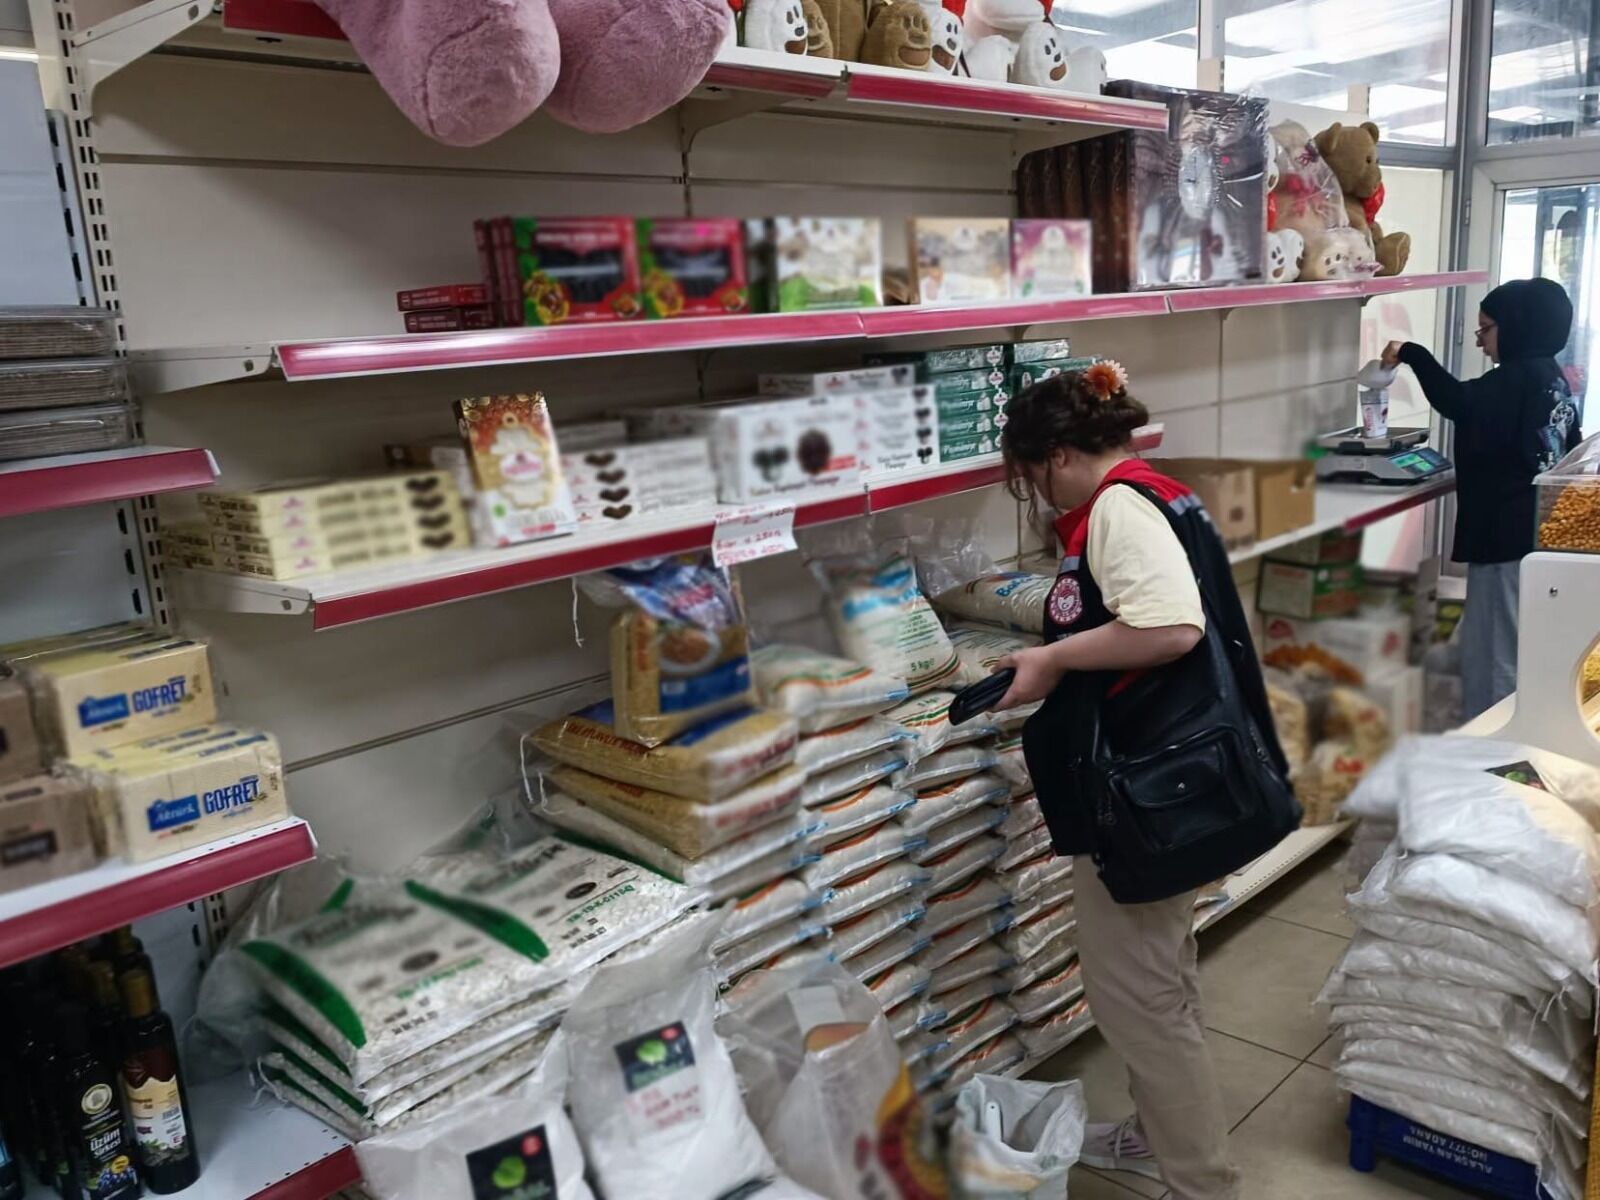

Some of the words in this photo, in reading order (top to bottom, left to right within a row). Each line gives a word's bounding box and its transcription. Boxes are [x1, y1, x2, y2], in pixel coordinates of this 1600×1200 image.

[132, 679, 186, 713] GOFRET
[203, 779, 259, 814] GOFRET
[90, 1128, 120, 1151] Üzüm
